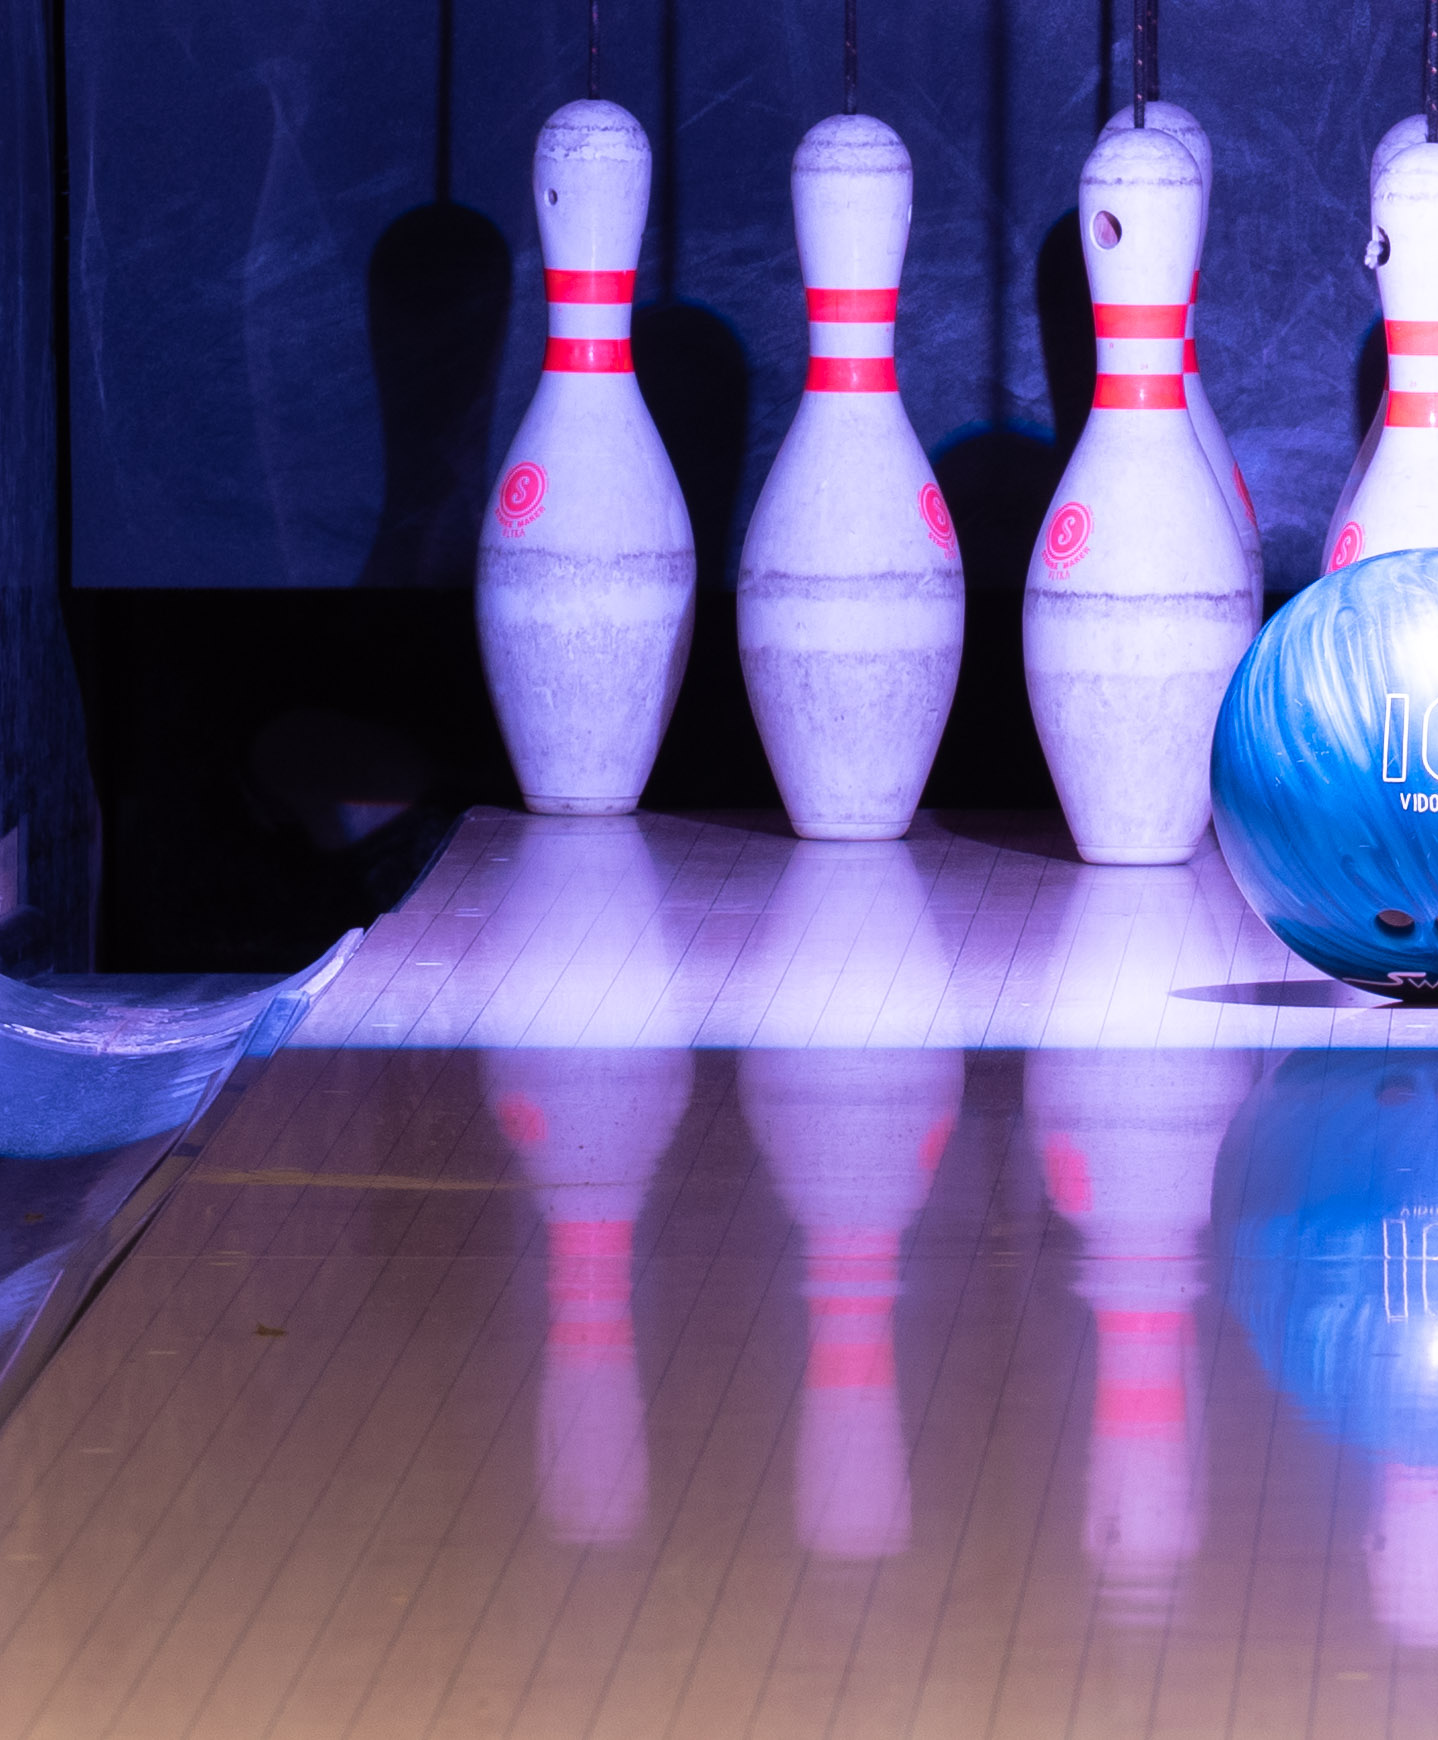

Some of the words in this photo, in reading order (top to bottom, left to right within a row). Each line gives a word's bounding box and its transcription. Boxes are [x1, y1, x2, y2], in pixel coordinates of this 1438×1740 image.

[512, 476, 530, 504] S
[1057, 516, 1075, 546] S
[1336, 535, 1352, 565] S
